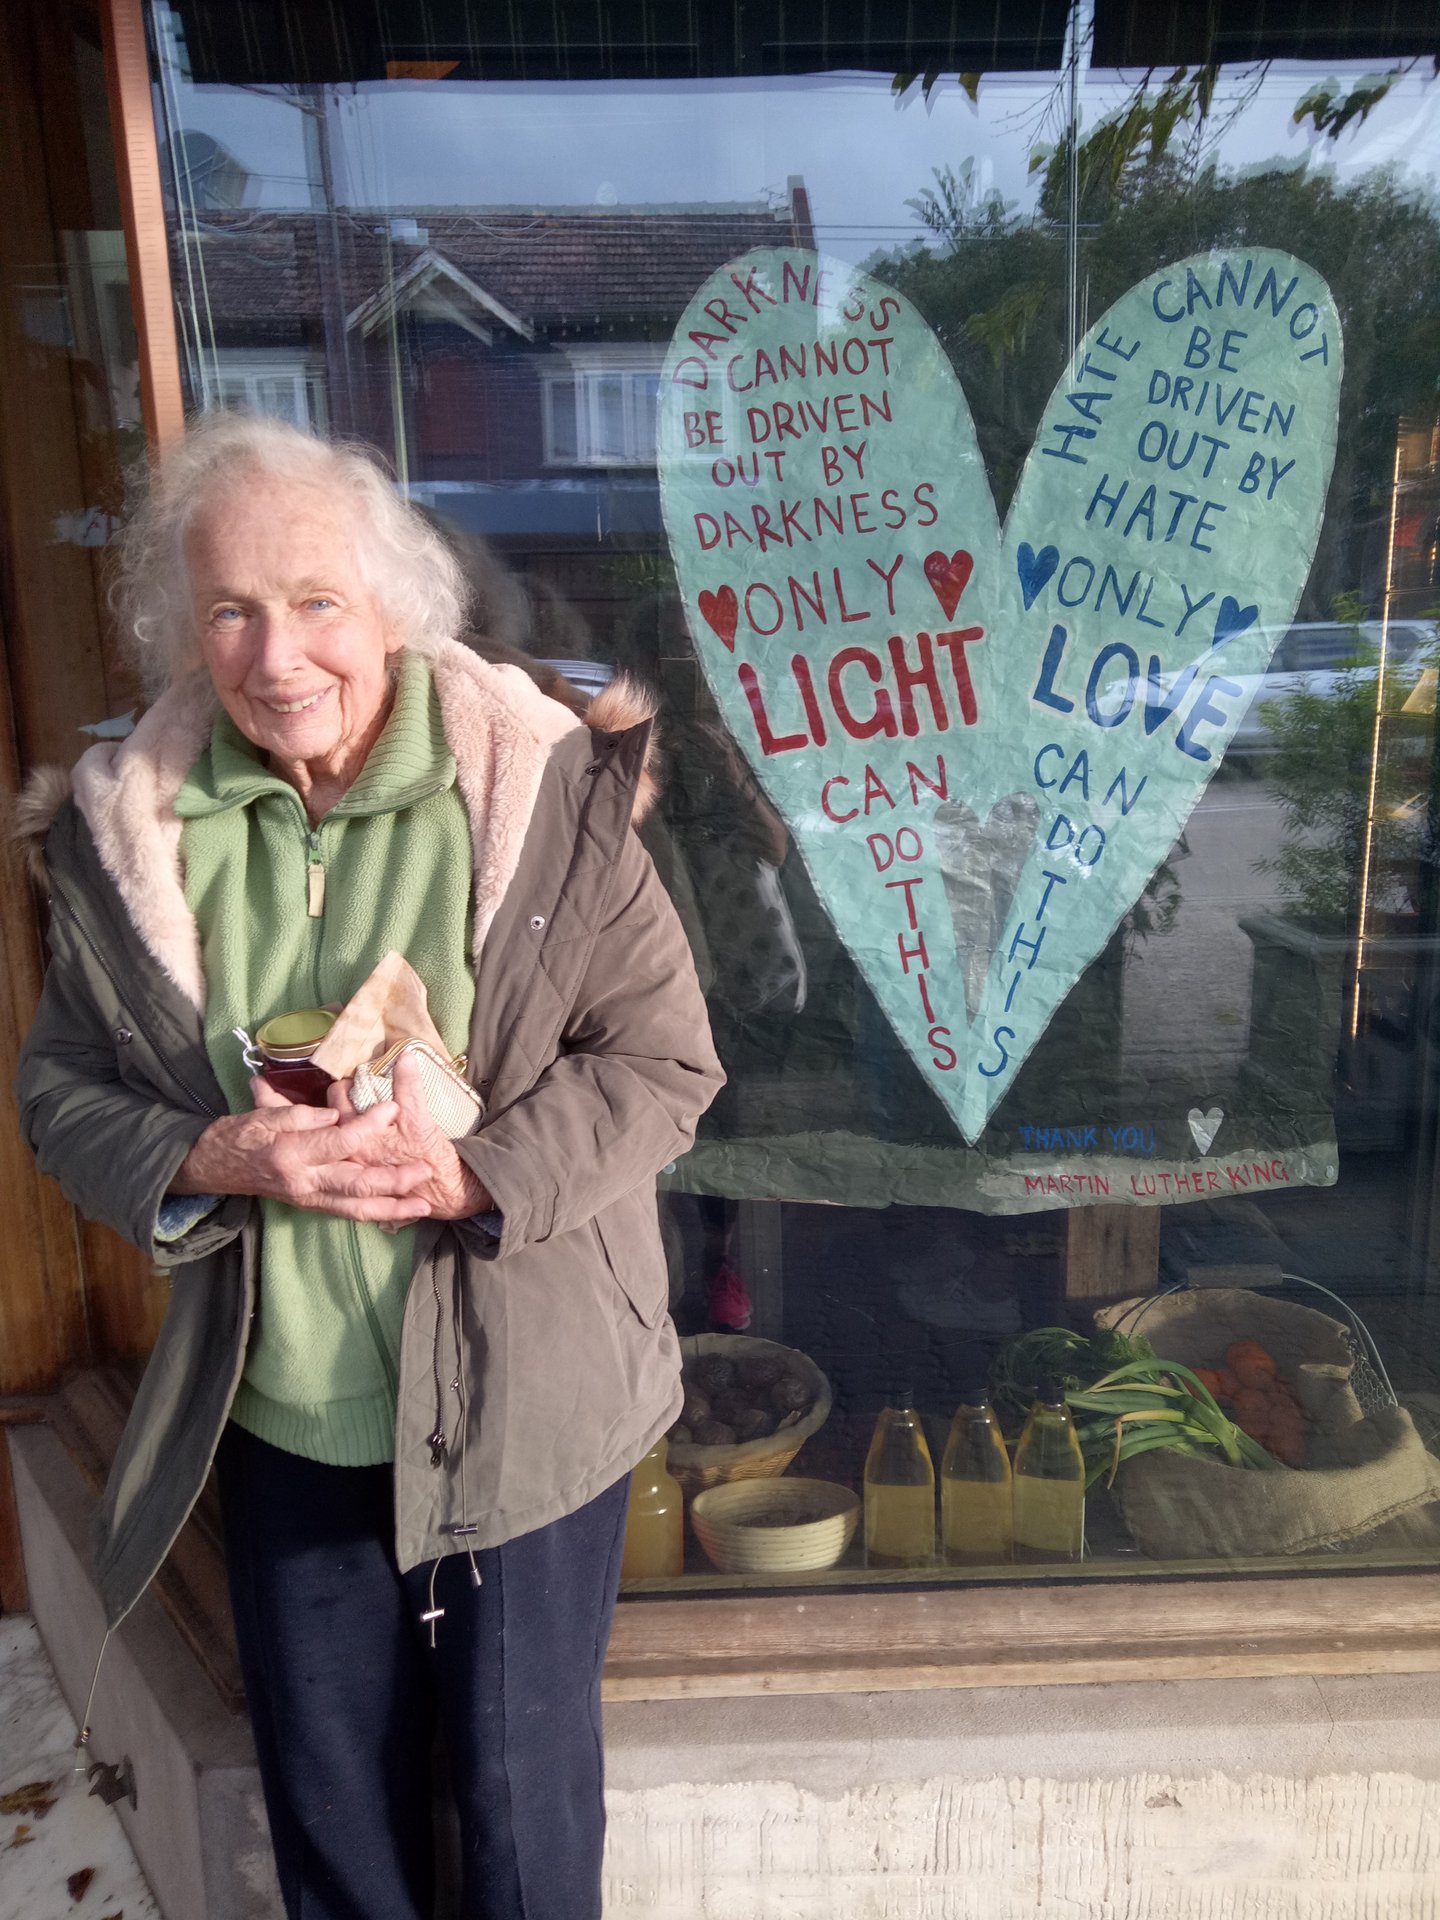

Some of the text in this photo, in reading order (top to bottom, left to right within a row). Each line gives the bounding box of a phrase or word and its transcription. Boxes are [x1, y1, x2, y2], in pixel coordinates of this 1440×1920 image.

[672, 261, 900, 390] DARKNESS
[1184, 326, 1248, 373] BE
[727, 337, 894, 392] CANNOT
[1042, 259, 1329, 465] HATE CANNOT
[684, 390, 893, 448] BE DRIVEN
[1149, 369, 1296, 437] DRIVEN
[712, 441, 867, 487] OUT BY
[1138, 421, 1296, 500] OUT BY
[694, 483, 938, 552] DARKNESS
[1085, 474, 1227, 553] HATE
[745, 554, 904, 635] ONLY
[1057, 556, 1216, 637] ONLY
[738, 626, 984, 756] LIGHT
[1032, 624, 1243, 762] LOVE
[821, 754, 947, 823] CAN
[1034, 743, 1148, 816] CAN
[866, 827, 923, 872] DO
[1046, 814, 1106, 866] DO
[885, 877, 957, 1070] THIS
[978, 870, 1067, 1077] THIS
[1019, 1126, 1155, 1153] THANK YOU
[1024, 1159, 1289, 1197] MARTIN LUTHER KING
